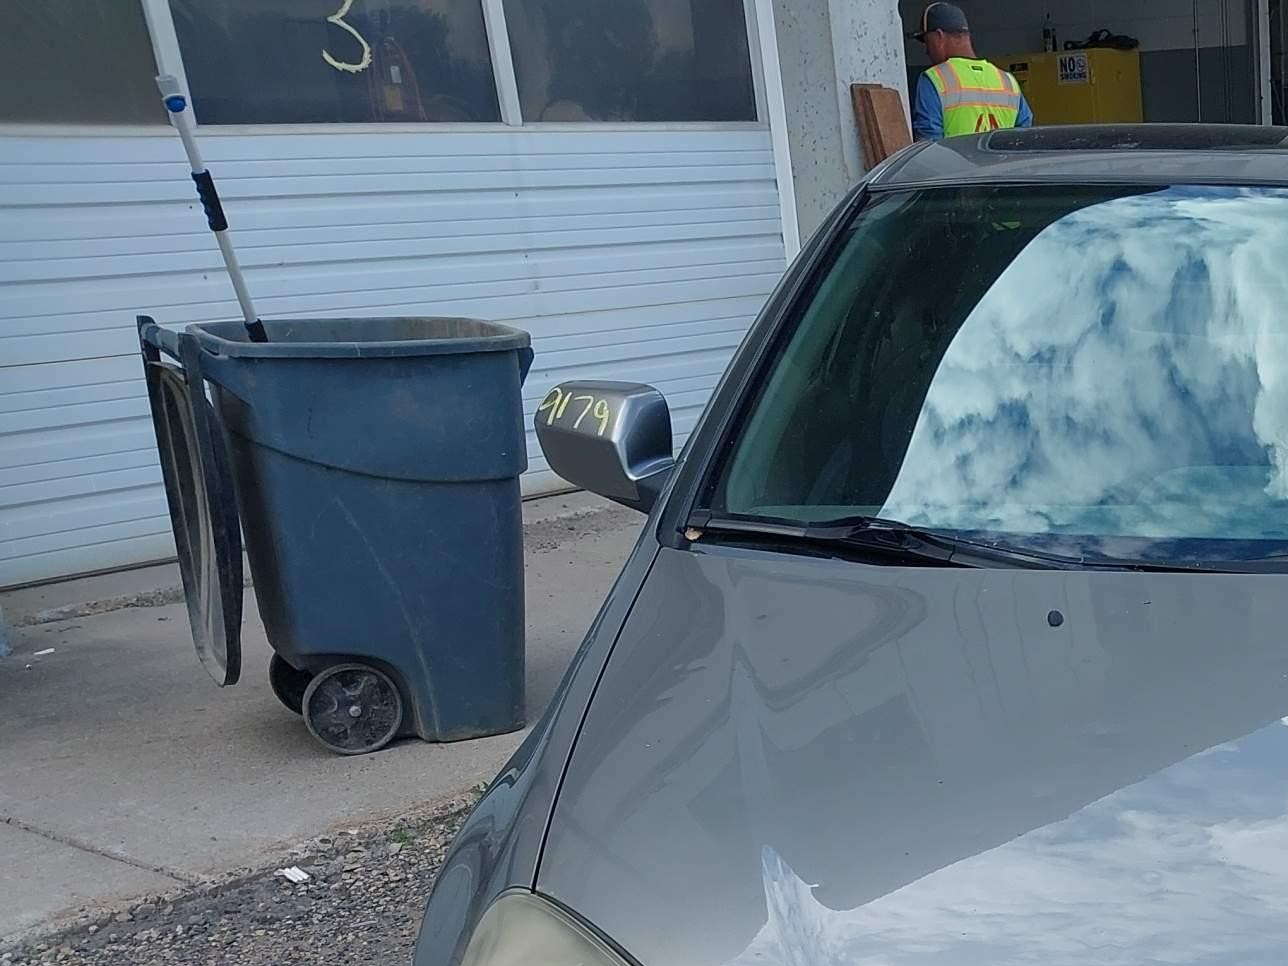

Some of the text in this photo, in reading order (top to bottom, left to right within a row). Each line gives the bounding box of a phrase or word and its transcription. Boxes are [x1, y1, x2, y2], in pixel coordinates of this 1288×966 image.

[322, 0, 372, 73] 3
[1060, 57, 1075, 72] NO
[540, 387, 609, 436] 9179
